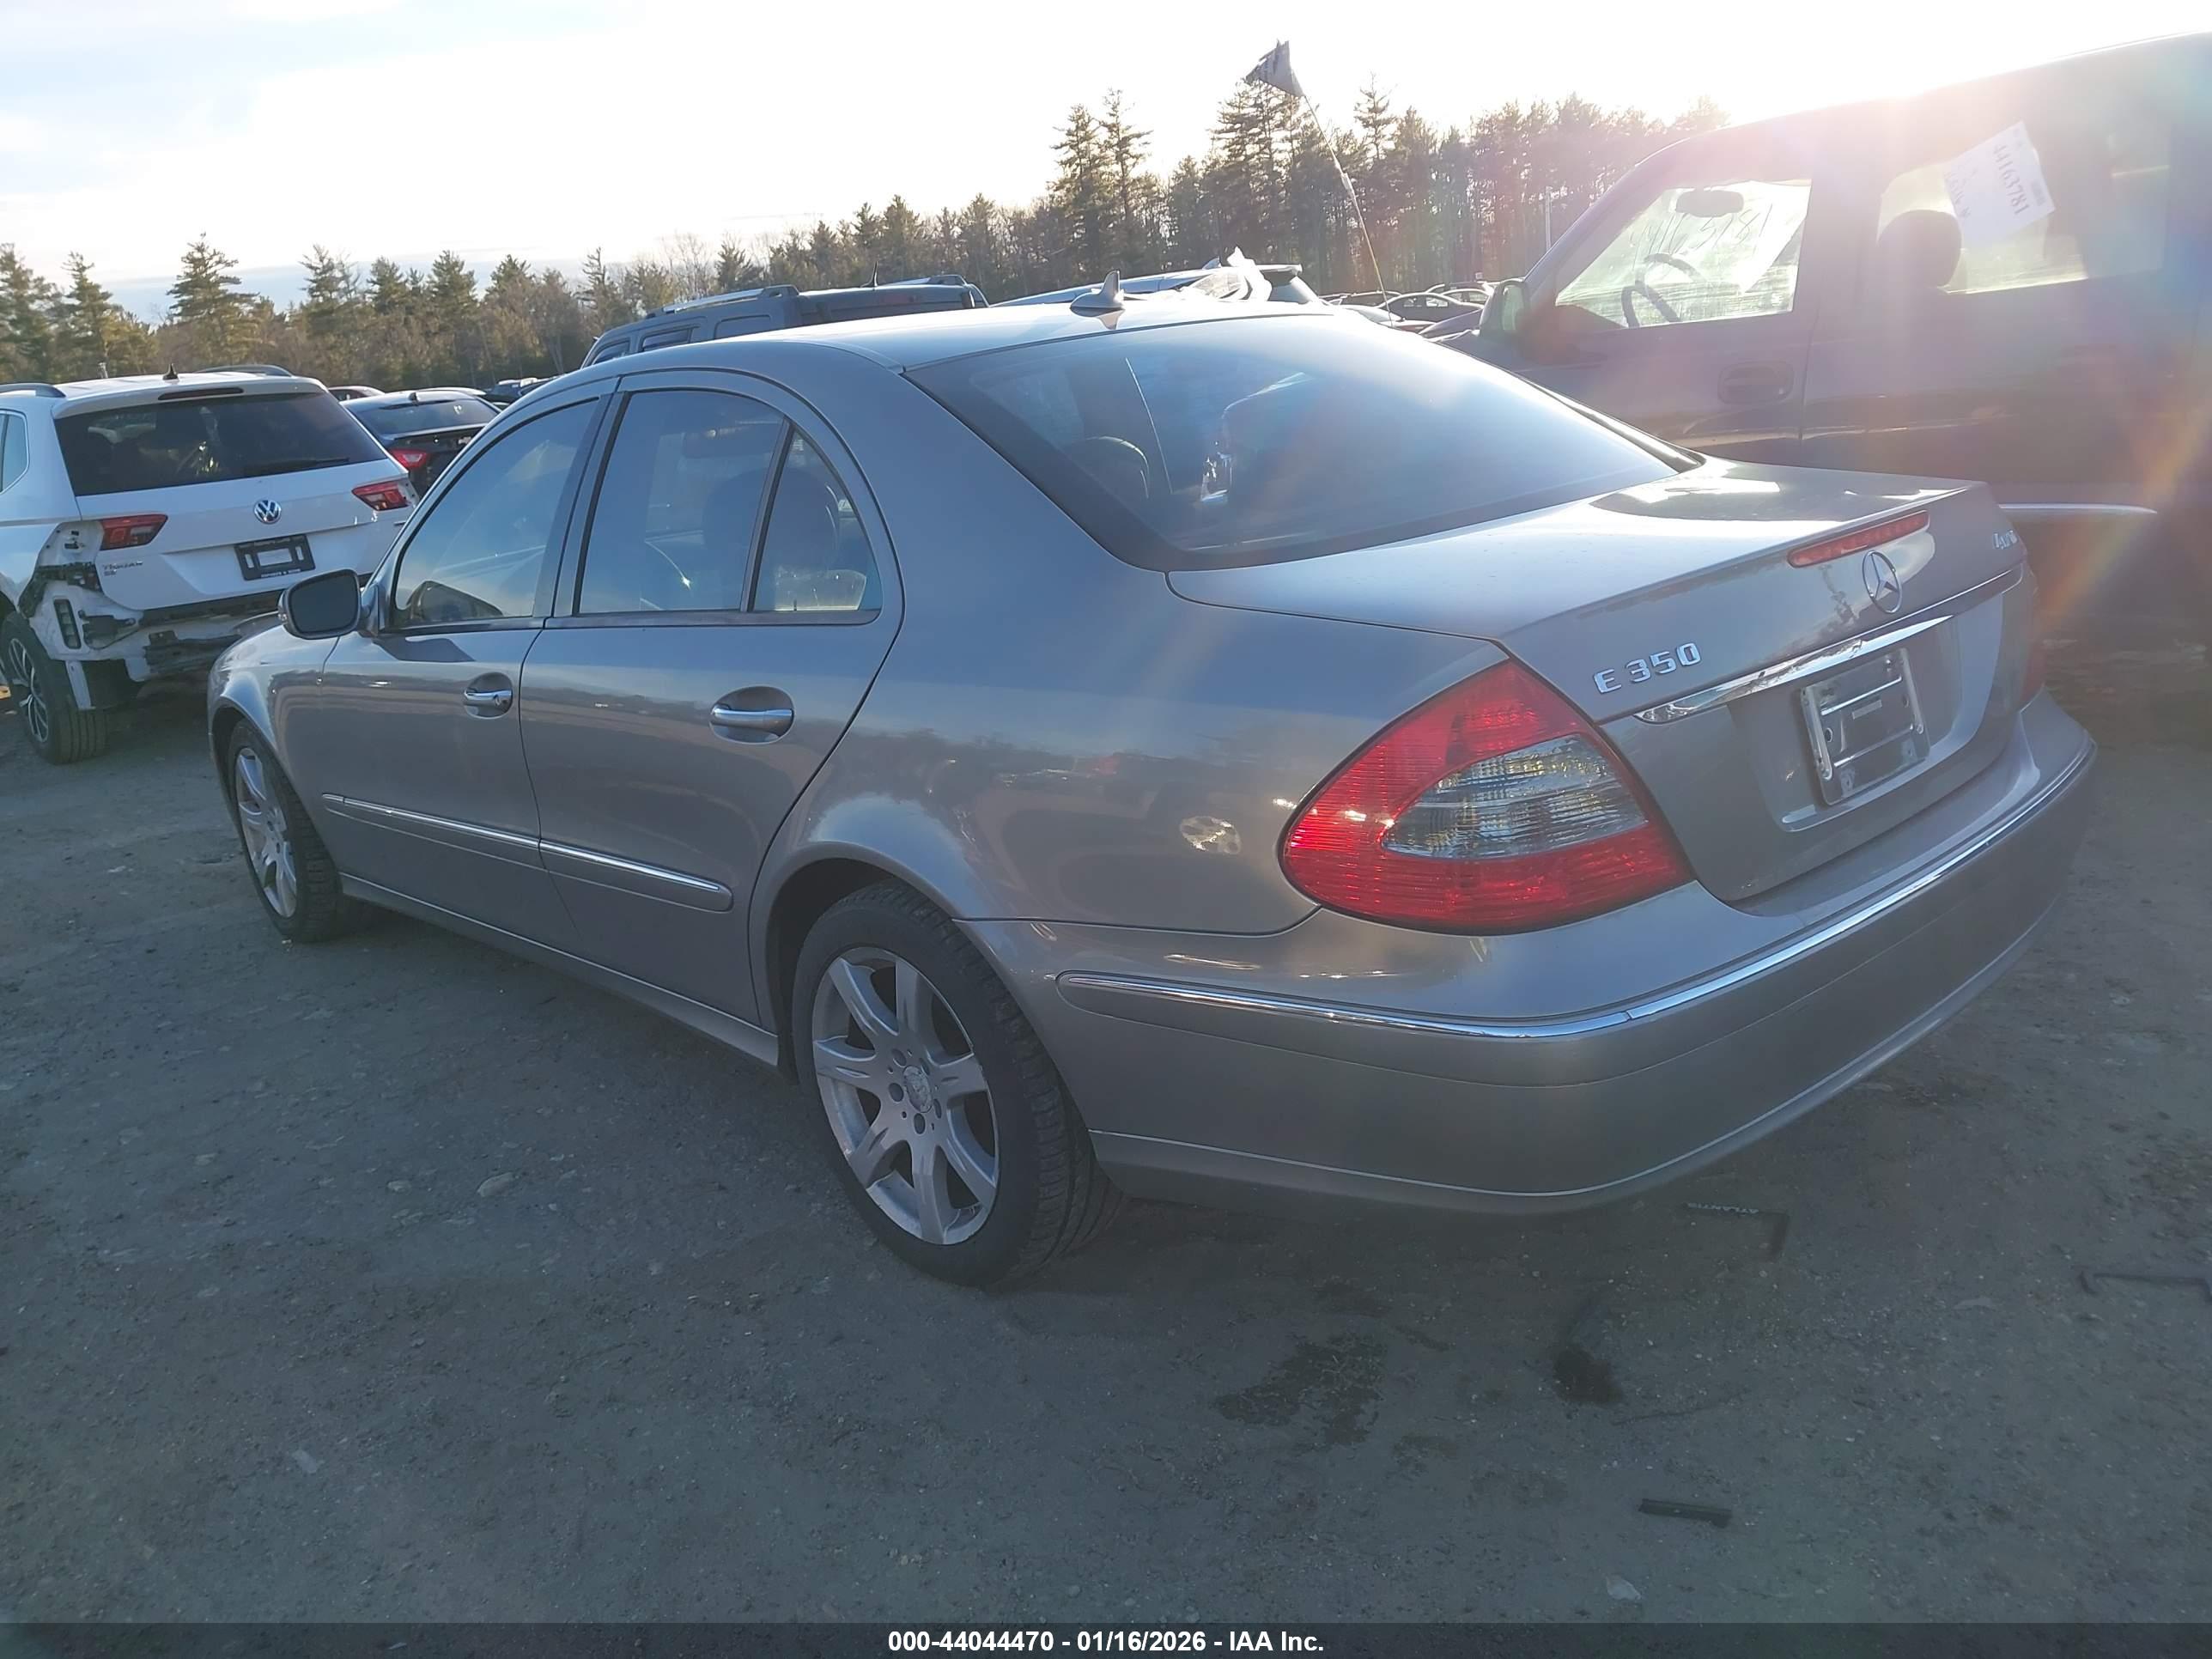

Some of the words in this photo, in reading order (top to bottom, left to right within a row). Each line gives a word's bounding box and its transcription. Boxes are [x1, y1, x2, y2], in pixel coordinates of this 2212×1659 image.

[1992, 144, 2030, 215] 44163781
[1594, 669, 1622, 694] E
[1625, 642, 1701, 684] 350
